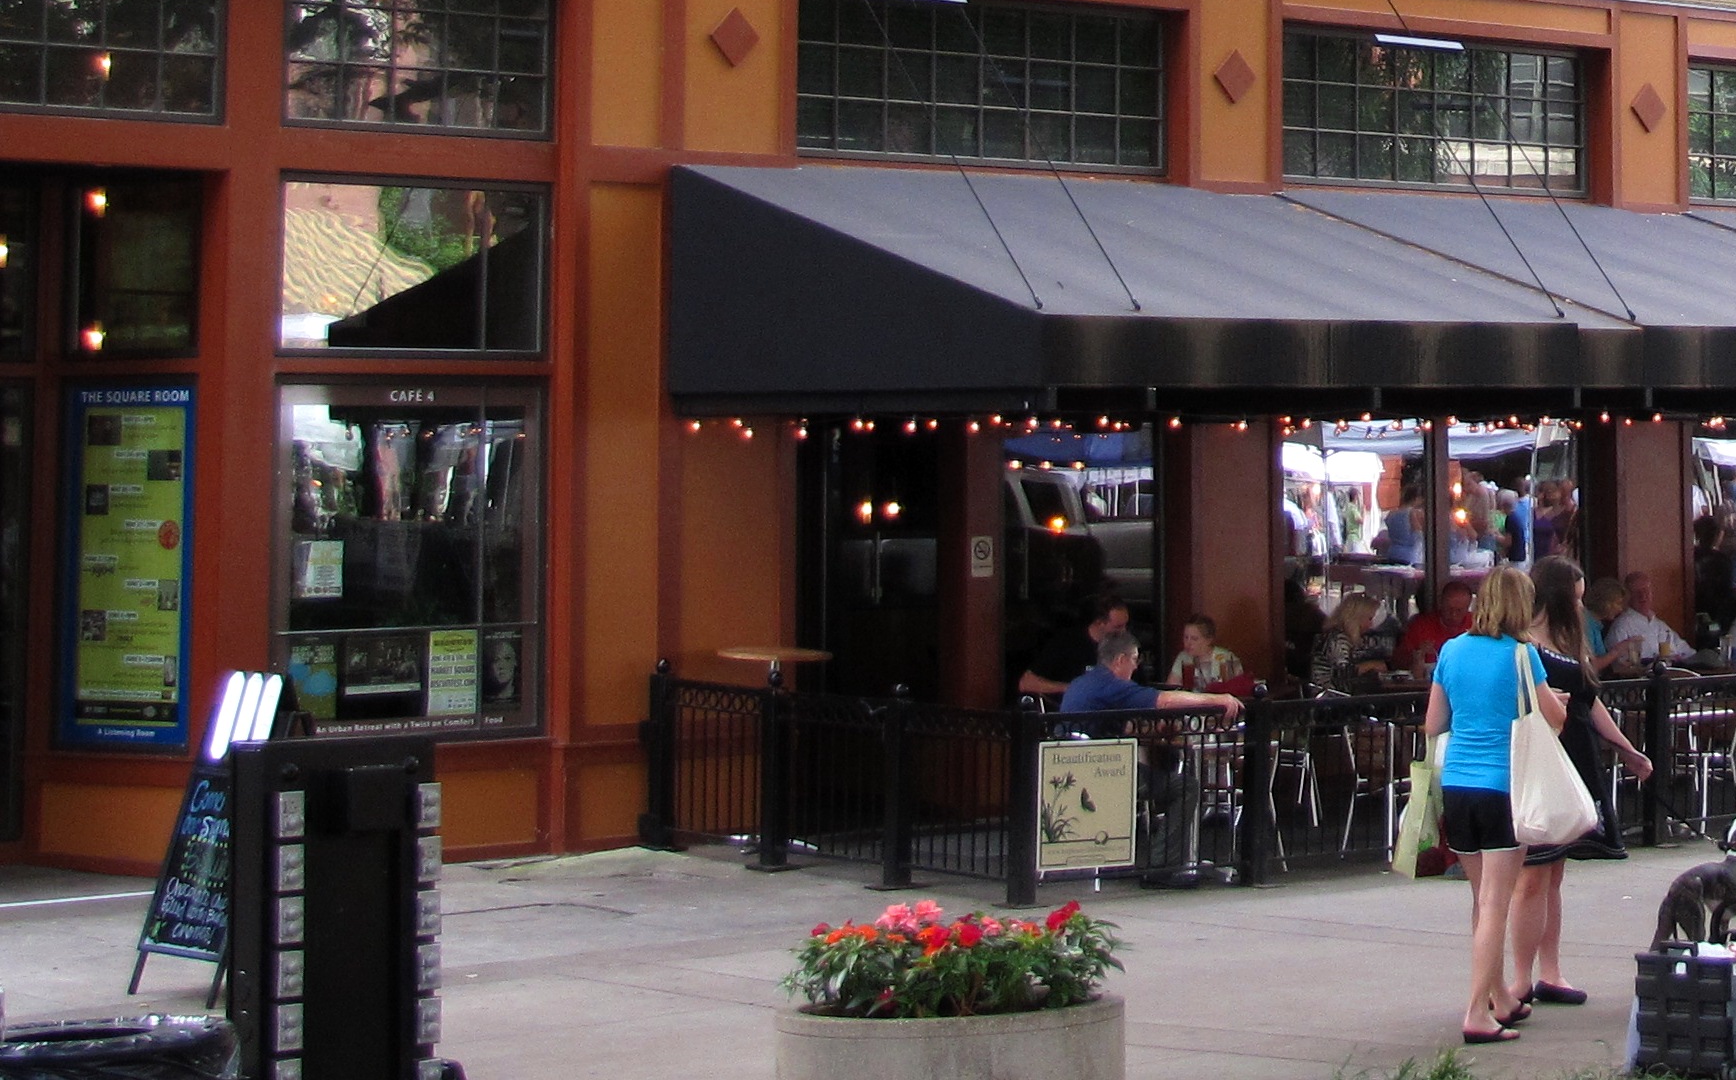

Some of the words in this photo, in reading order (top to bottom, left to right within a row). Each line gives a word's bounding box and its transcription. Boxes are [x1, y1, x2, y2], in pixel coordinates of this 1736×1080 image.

[81, 391, 103, 403] THE
[106, 390, 151, 404] SQUARE
[154, 389, 190, 402] ROOM
[390, 388, 423, 402] CAFÉ
[427, 390, 435, 402] 4
[316, 726, 327, 734] An
[328, 723, 352, 733] Urban
[354, 722, 383, 732] Retreat
[384, 722, 401, 730] with
[410, 720, 430, 729] Twist
[443, 718, 474, 727] Comfort
[484, 716, 504, 724] Food
[104, 727, 135, 738] Listening
[136, 728, 156, 737] Room
[1052, 751, 1122, 765] Beautification
[1094, 764, 1126, 777] Award
